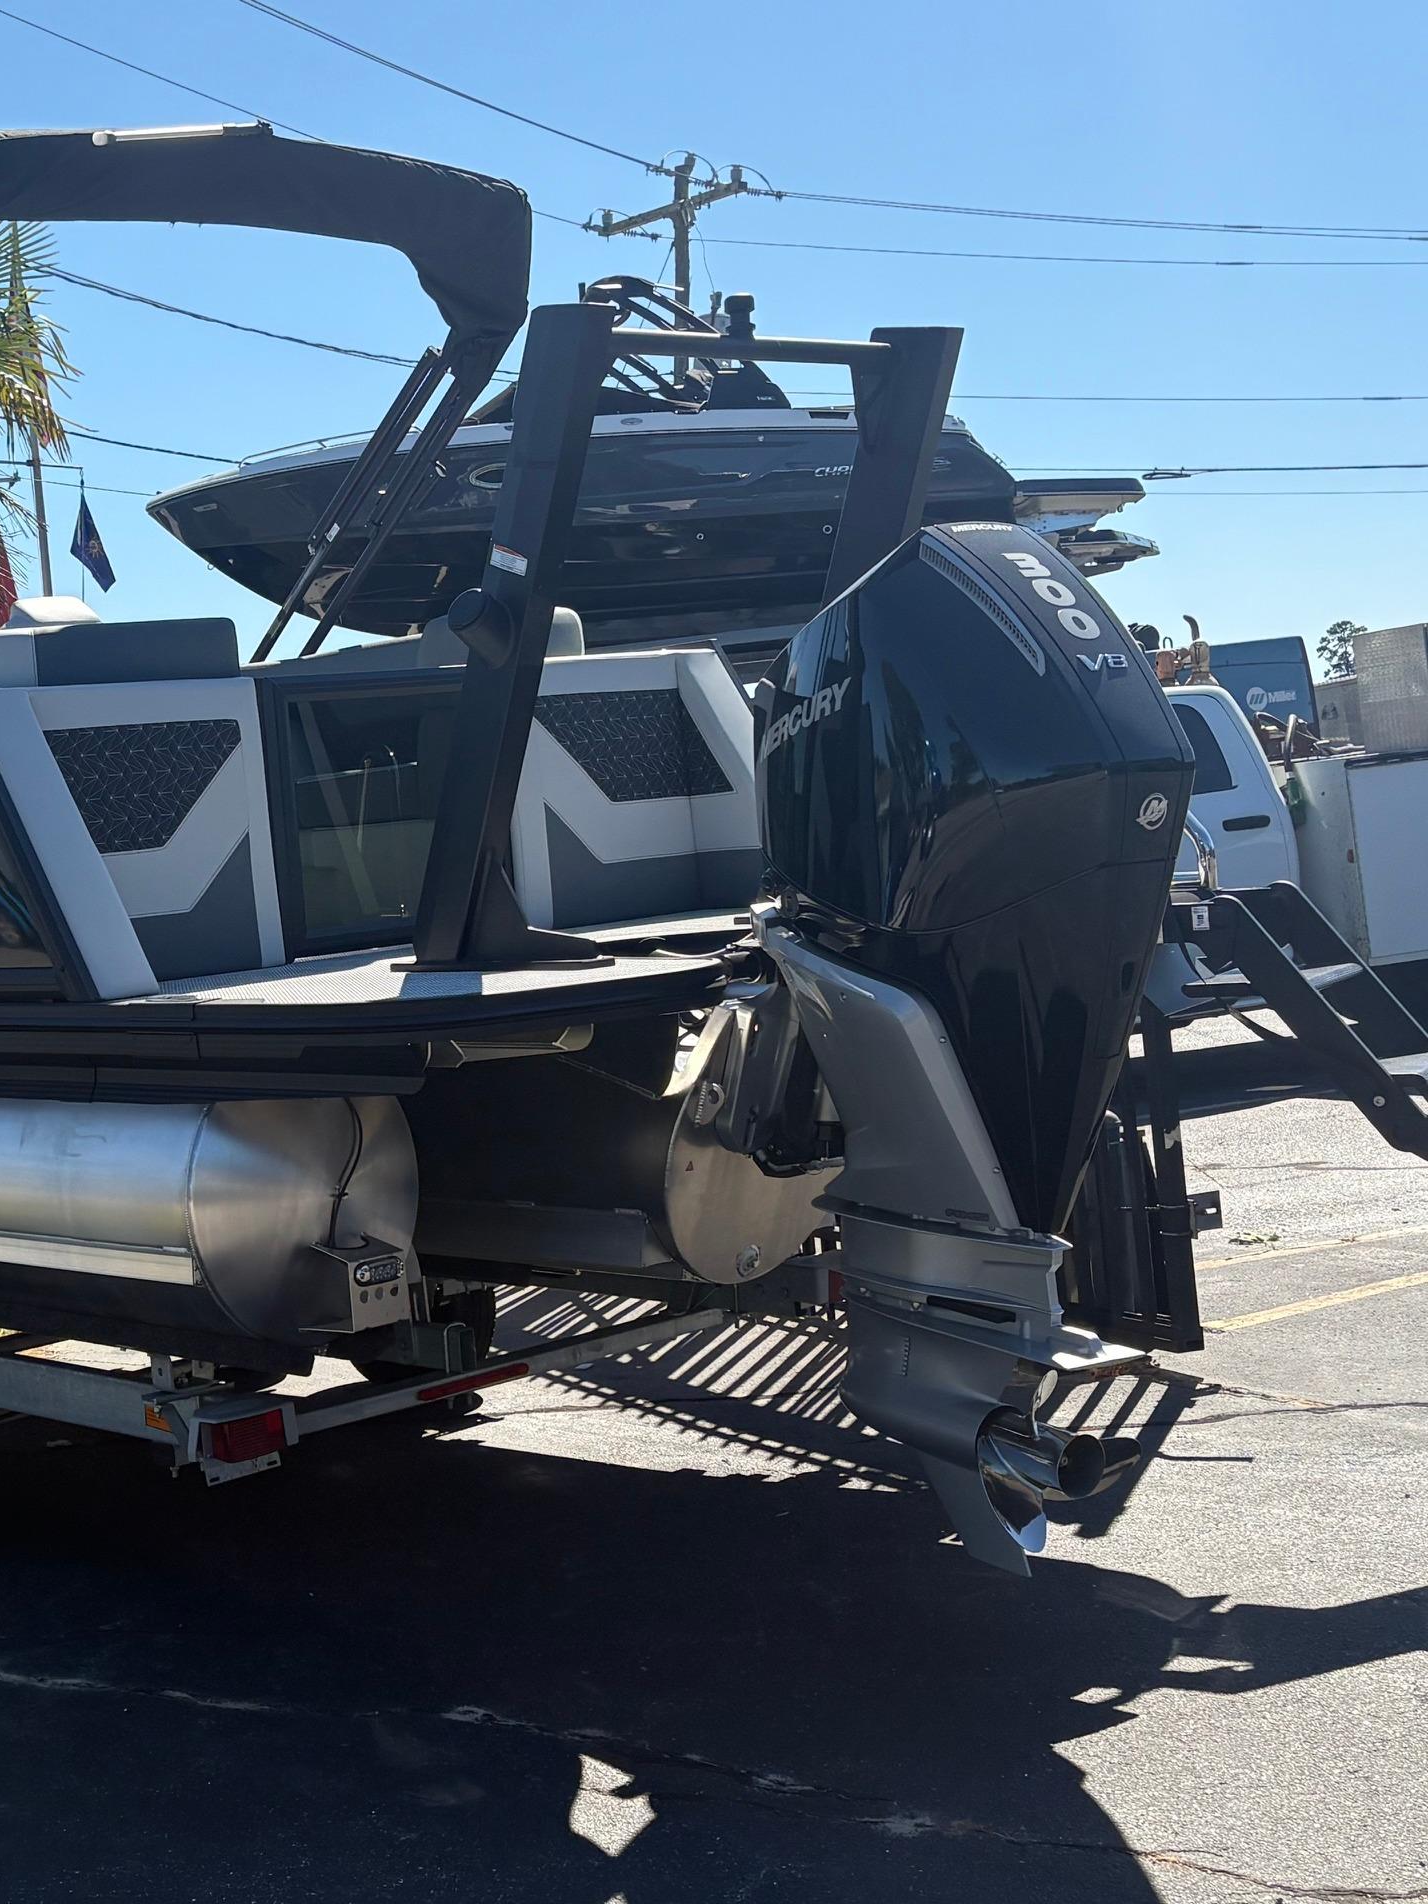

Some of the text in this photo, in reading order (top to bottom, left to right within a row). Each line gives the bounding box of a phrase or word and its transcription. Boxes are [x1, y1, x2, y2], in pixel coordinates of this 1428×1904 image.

[950, 523, 1013, 533] MERCURY
[1000, 552, 1101, 640] 300
[1076, 653, 1129, 671] V8
